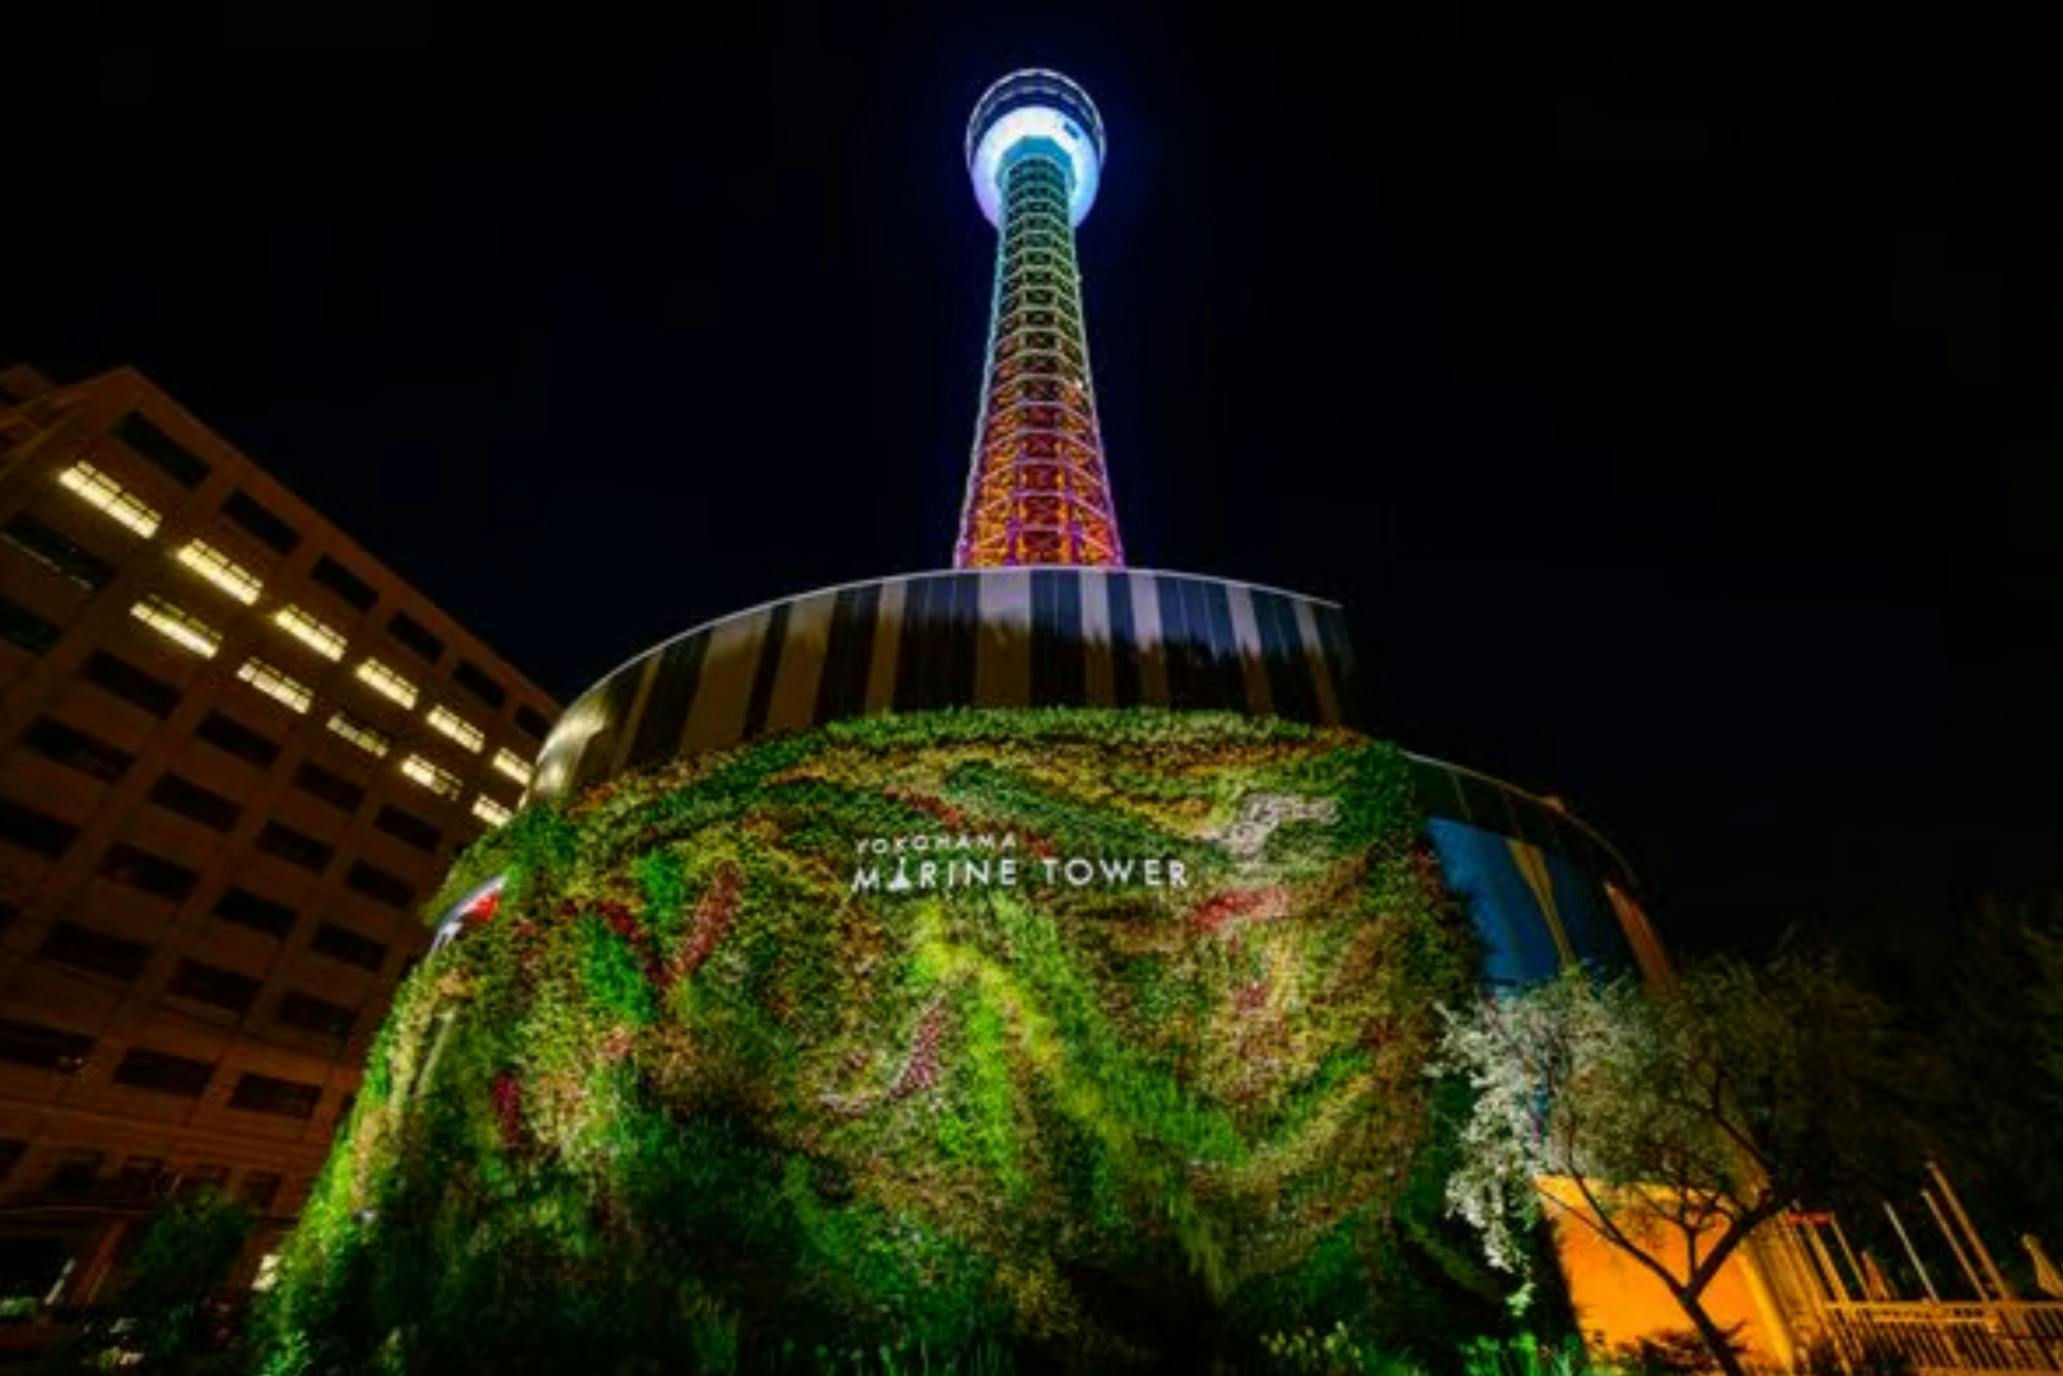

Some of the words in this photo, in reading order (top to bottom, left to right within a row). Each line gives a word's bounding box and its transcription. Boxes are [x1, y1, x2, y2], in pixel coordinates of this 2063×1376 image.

[855, 832, 1018, 854] YOKOHAMA
[852, 857, 1017, 892] MARINE
[1043, 857, 1188, 889] TOWER
